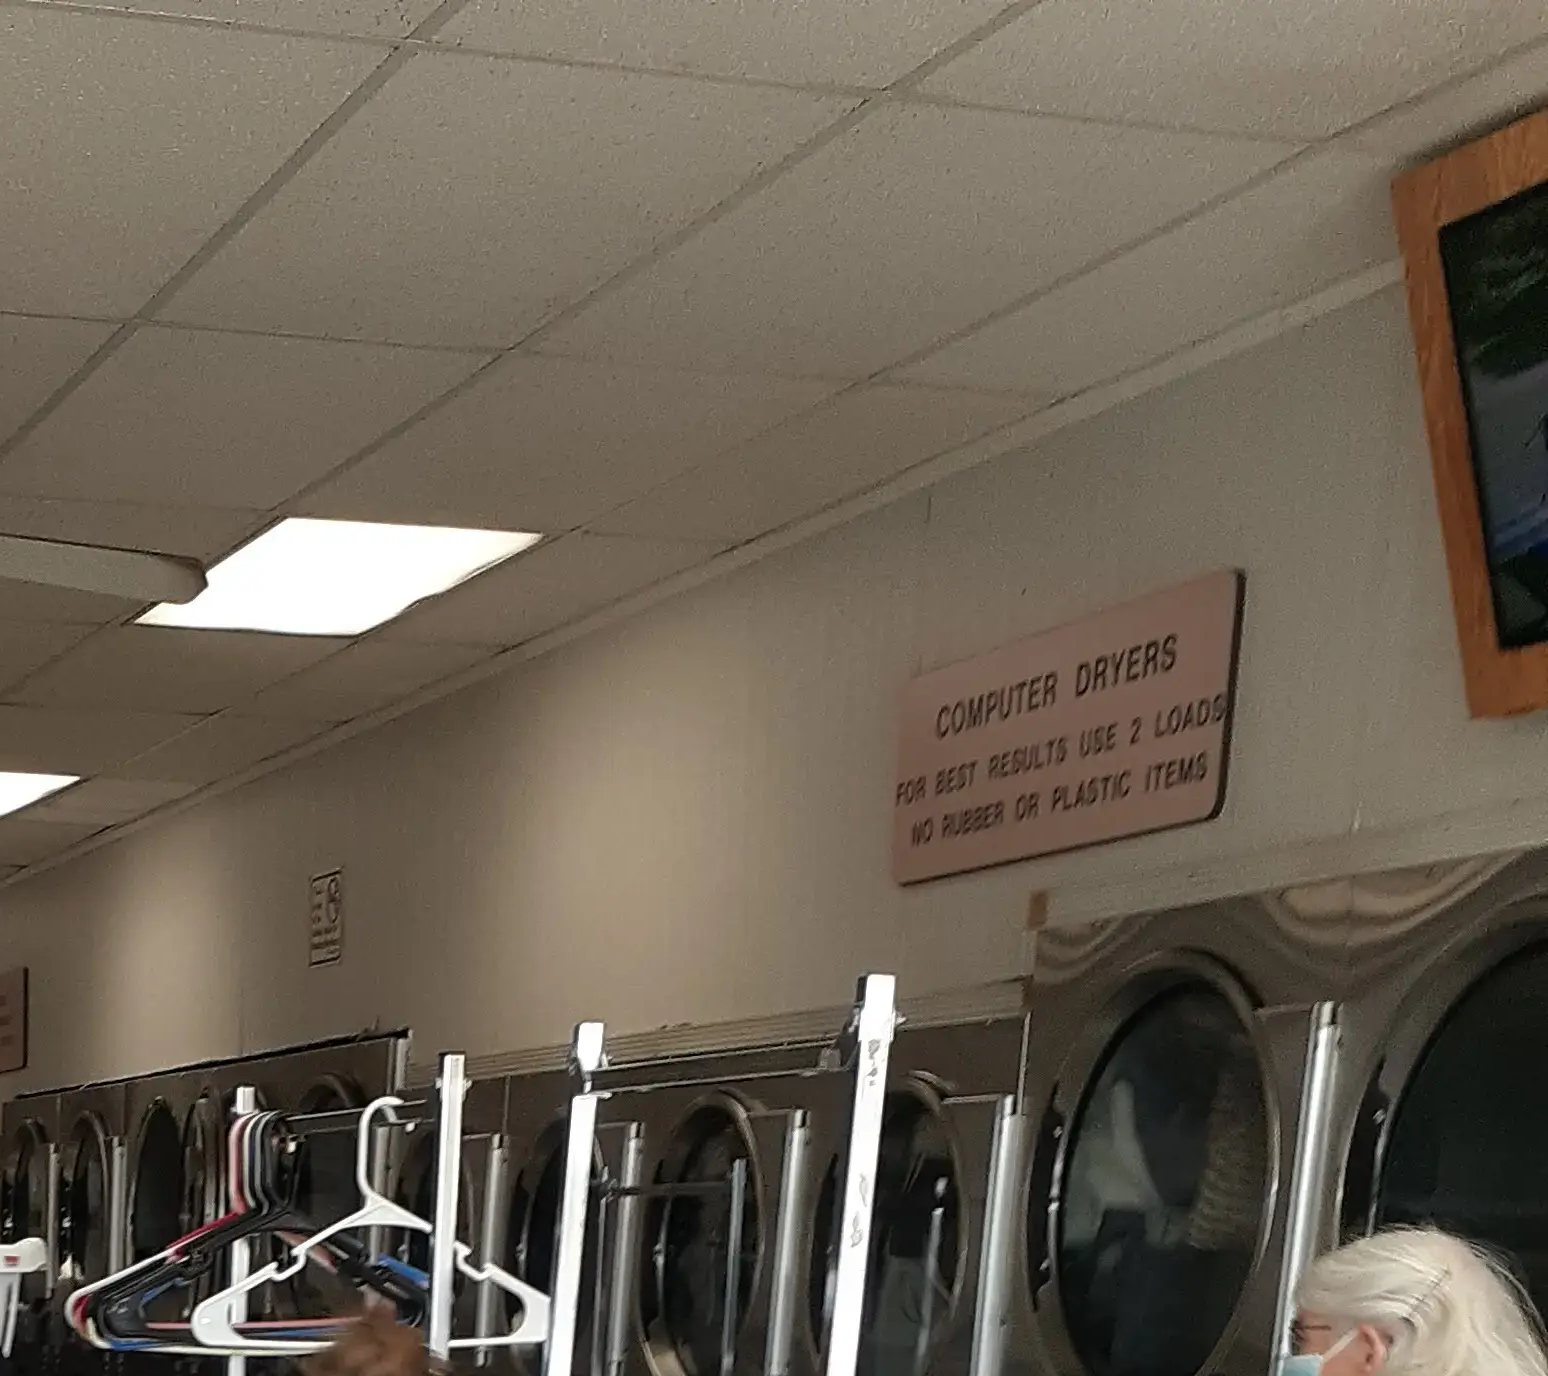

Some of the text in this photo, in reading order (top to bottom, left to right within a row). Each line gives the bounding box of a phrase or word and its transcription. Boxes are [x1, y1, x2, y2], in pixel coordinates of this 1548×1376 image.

[936, 633, 1179, 740] COMPUTER DRYERS
[895, 692, 1228, 807] FOR BEST RESULTS USE 2 LOADS
[912, 752, 1208, 848] NO RUBBER OR PLASTIC ITEMS
